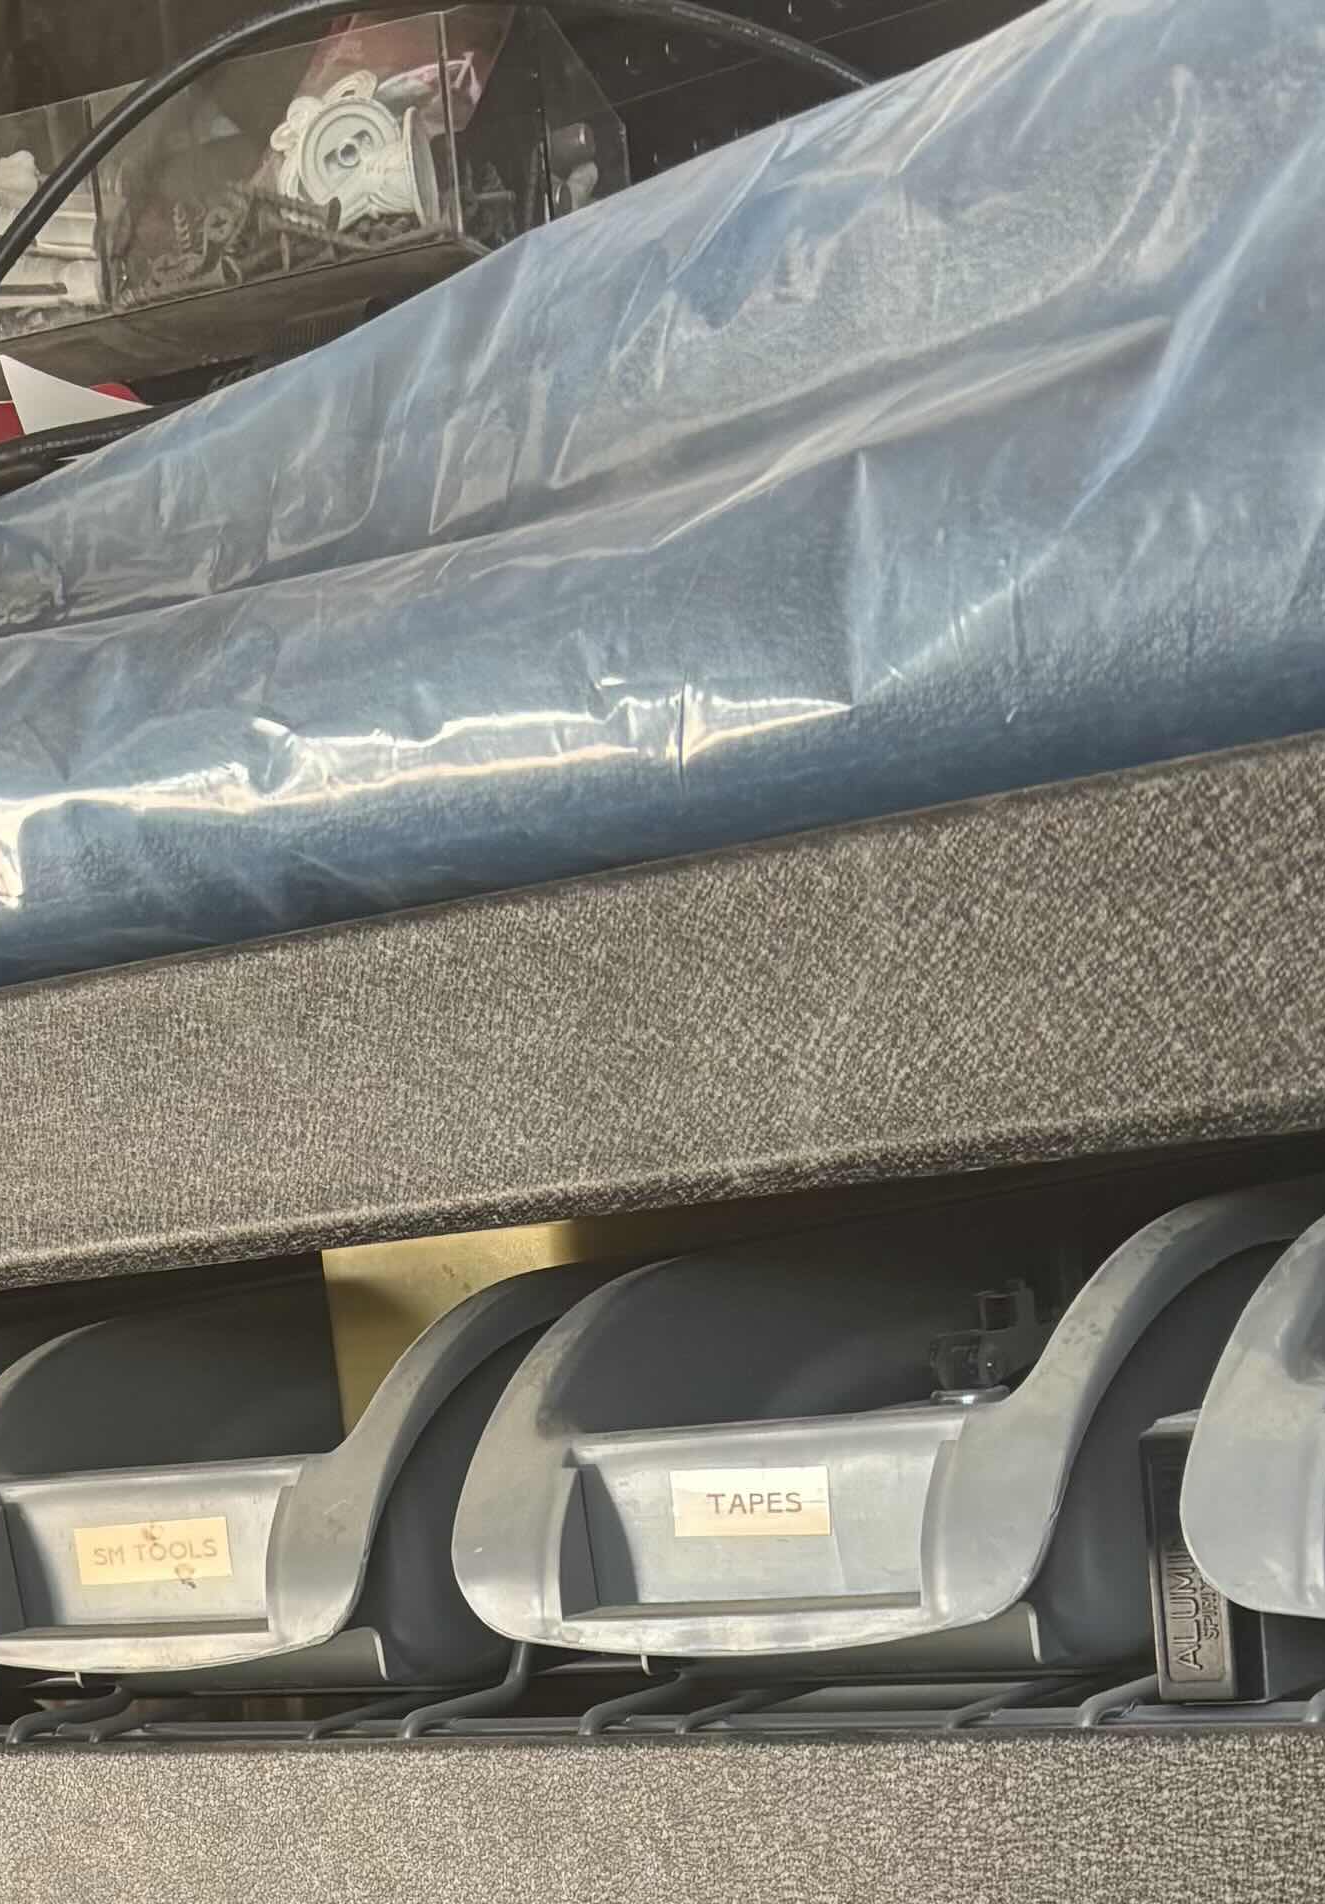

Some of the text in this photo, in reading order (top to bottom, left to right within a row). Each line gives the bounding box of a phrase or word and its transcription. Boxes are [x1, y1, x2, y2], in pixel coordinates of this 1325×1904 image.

[706, 1491, 802, 1515] TAPES
[93, 1538, 218, 1566] SM TOOLS
